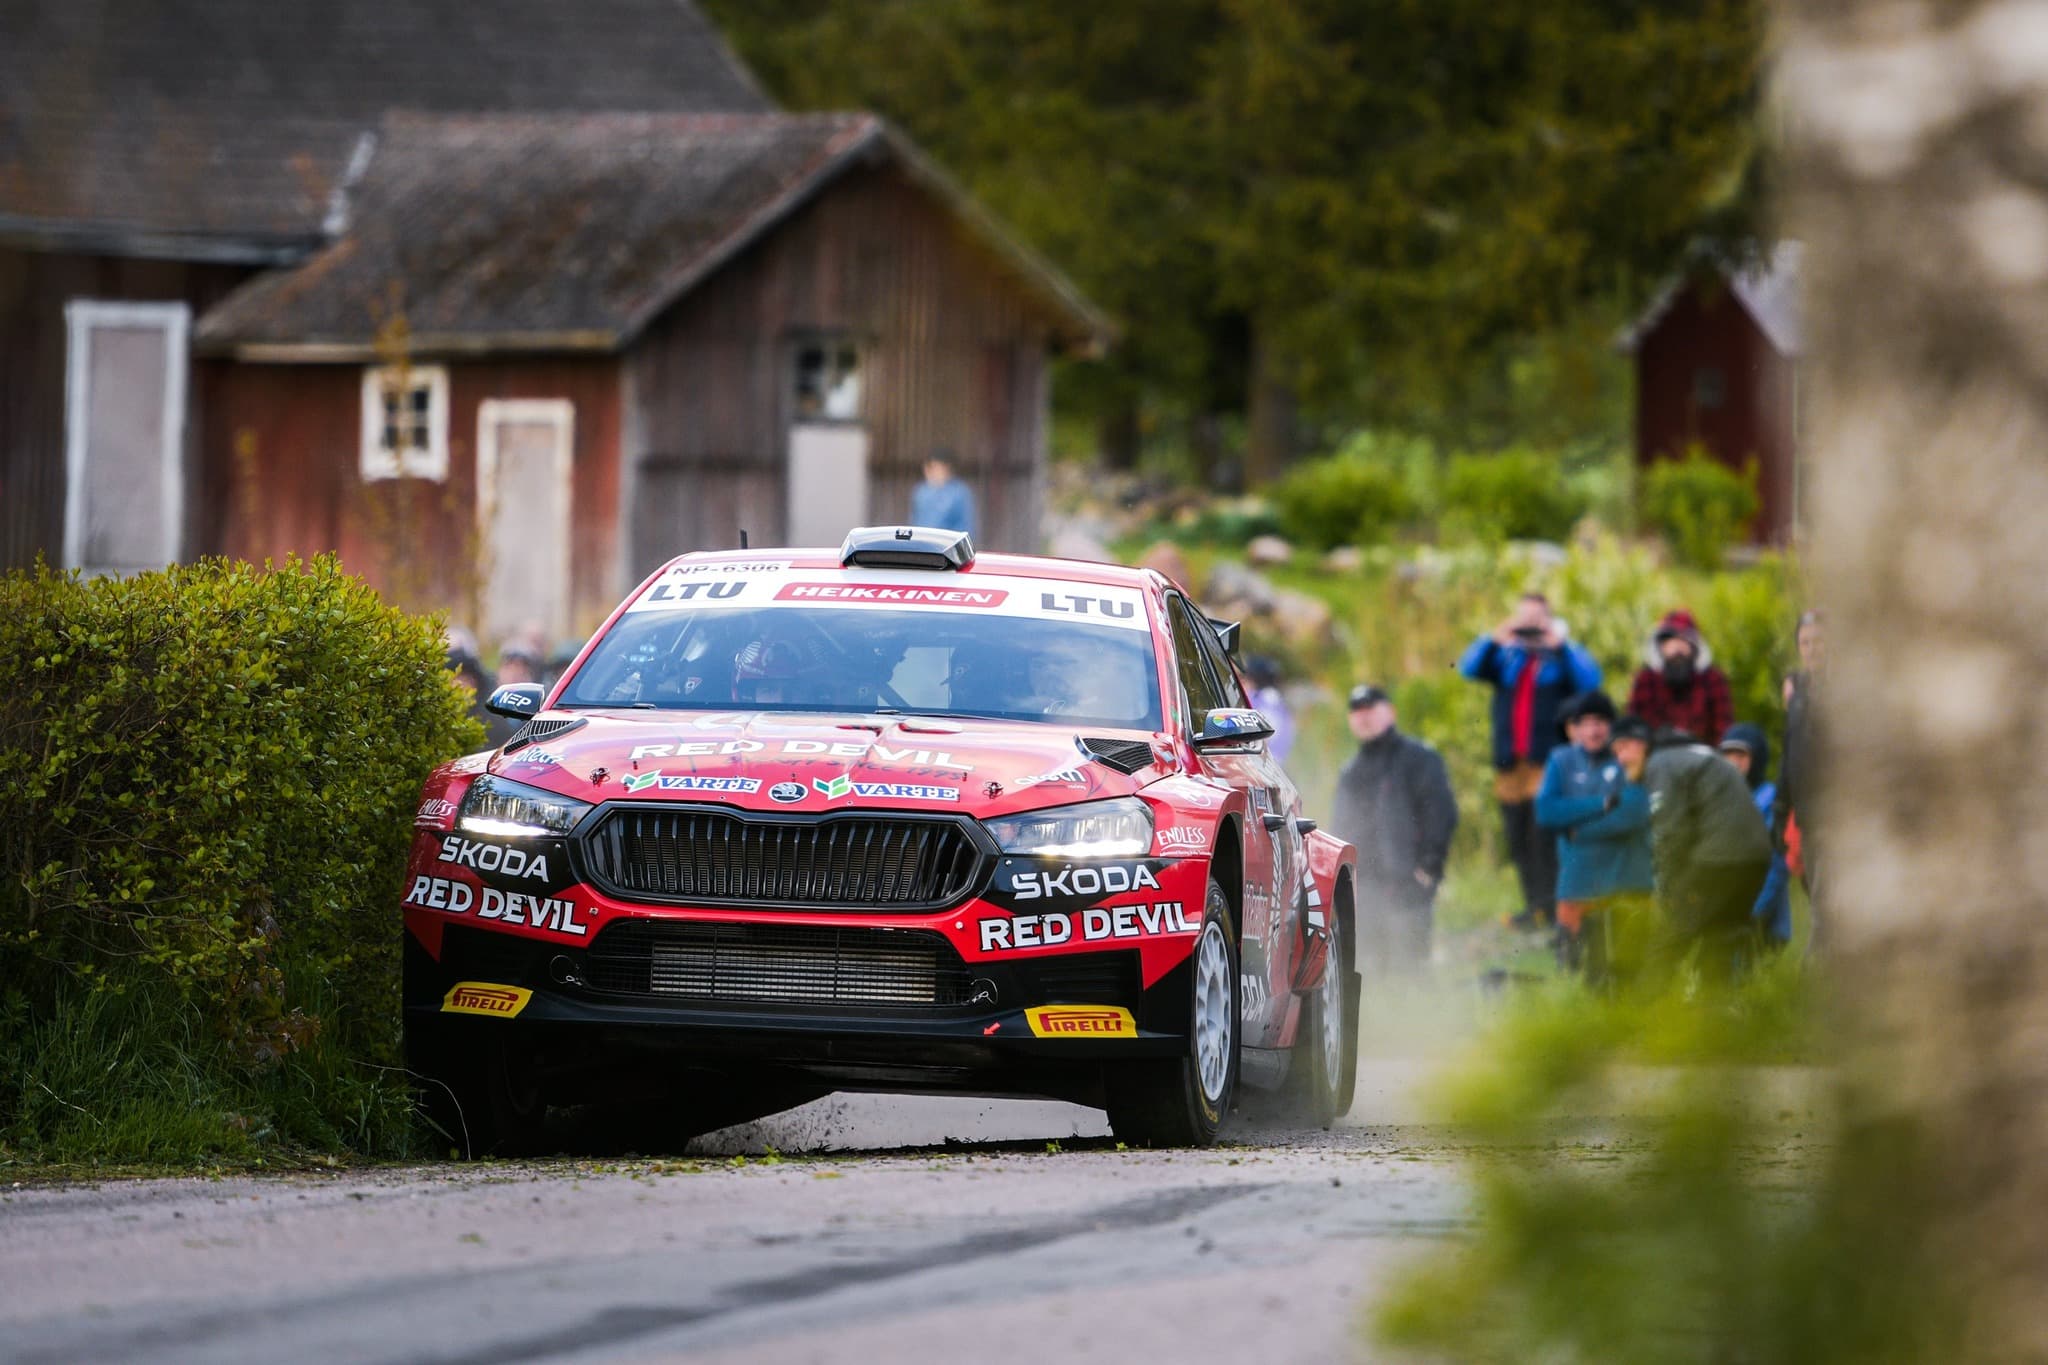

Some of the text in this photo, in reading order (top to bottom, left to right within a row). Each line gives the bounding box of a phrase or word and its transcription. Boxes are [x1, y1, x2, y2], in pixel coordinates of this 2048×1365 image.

[673, 563, 781, 576] NP-6306
[648, 581, 748, 601] LTU
[791, 585, 994, 604] HEIKKINEN
[1041, 592, 1135, 619] LTU
[628, 740, 765, 760] RED
[782, 740, 974, 771] DEVIL
[659, 777, 759, 792] VARTE
[854, 784, 956, 799] VARTE
[1156, 825, 1207, 846] ENDLESS
[406, 876, 587, 935] RED DEVIL
[980, 913, 1071, 951] RED
[1082, 903, 1201, 940] DEVIL
[452, 987, 519, 1012] PIRELLI
[1038, 1011, 1122, 1032] PIRELLI
